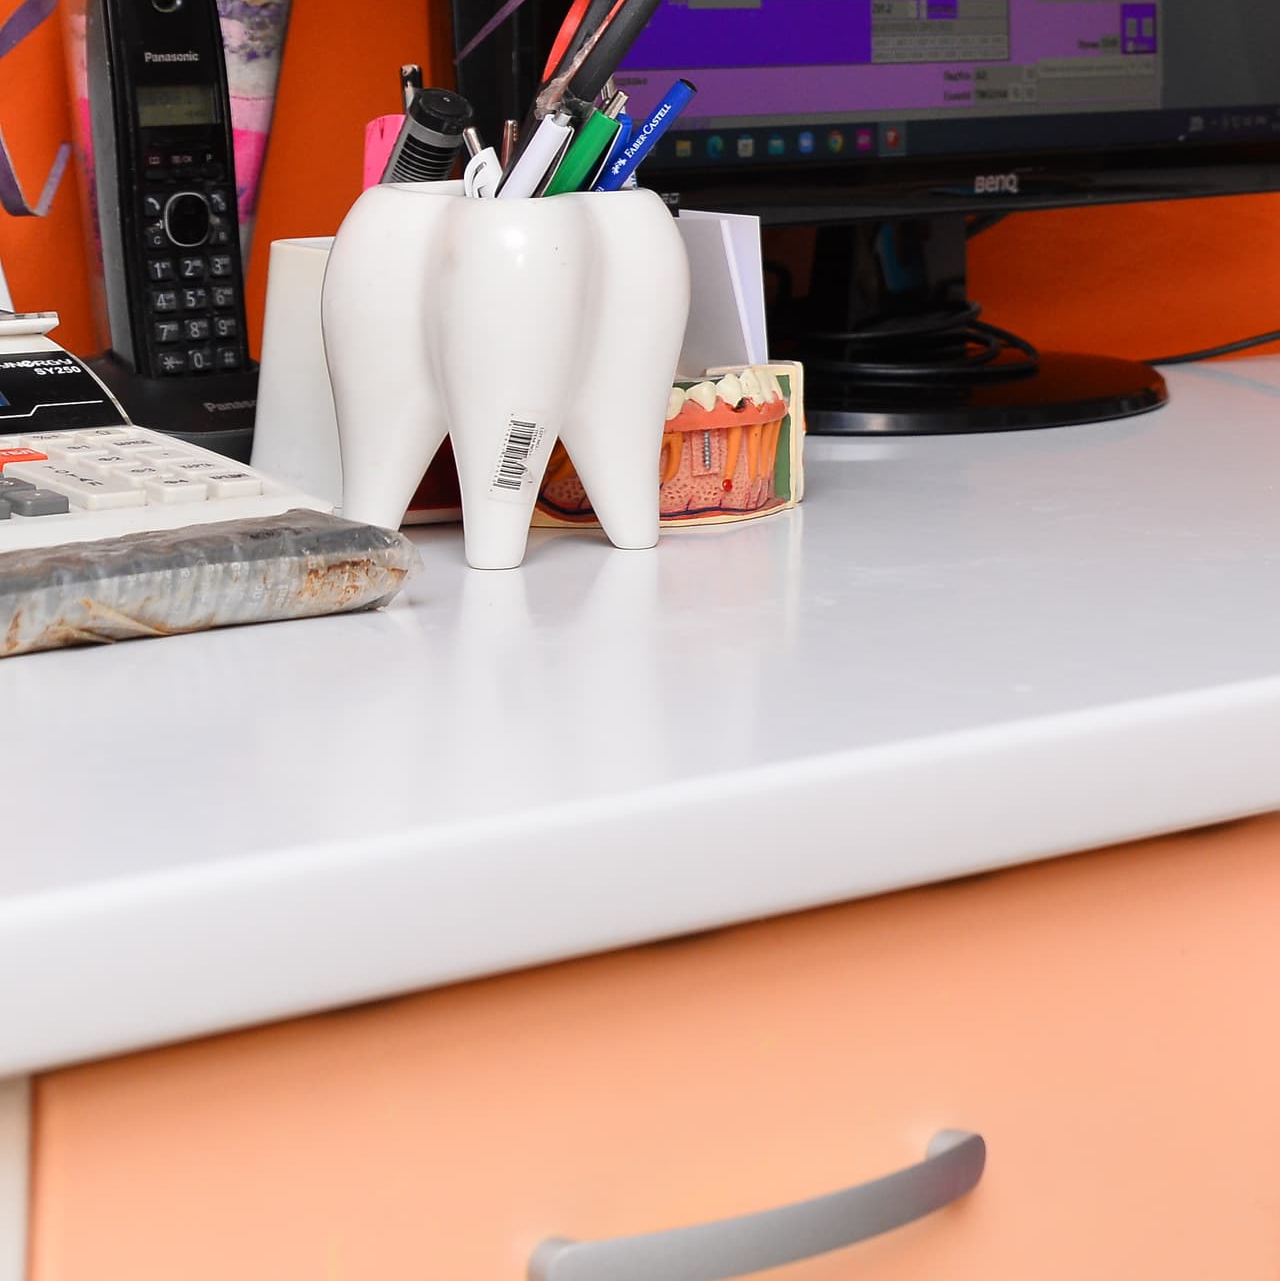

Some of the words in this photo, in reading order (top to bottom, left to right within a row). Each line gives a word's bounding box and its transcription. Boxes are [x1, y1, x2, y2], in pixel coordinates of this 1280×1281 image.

[144, 51, 199, 62] Panasonic
[624, 104, 672, 158] FABER-CASTELL
[34, 366, 82, 375] SY250
